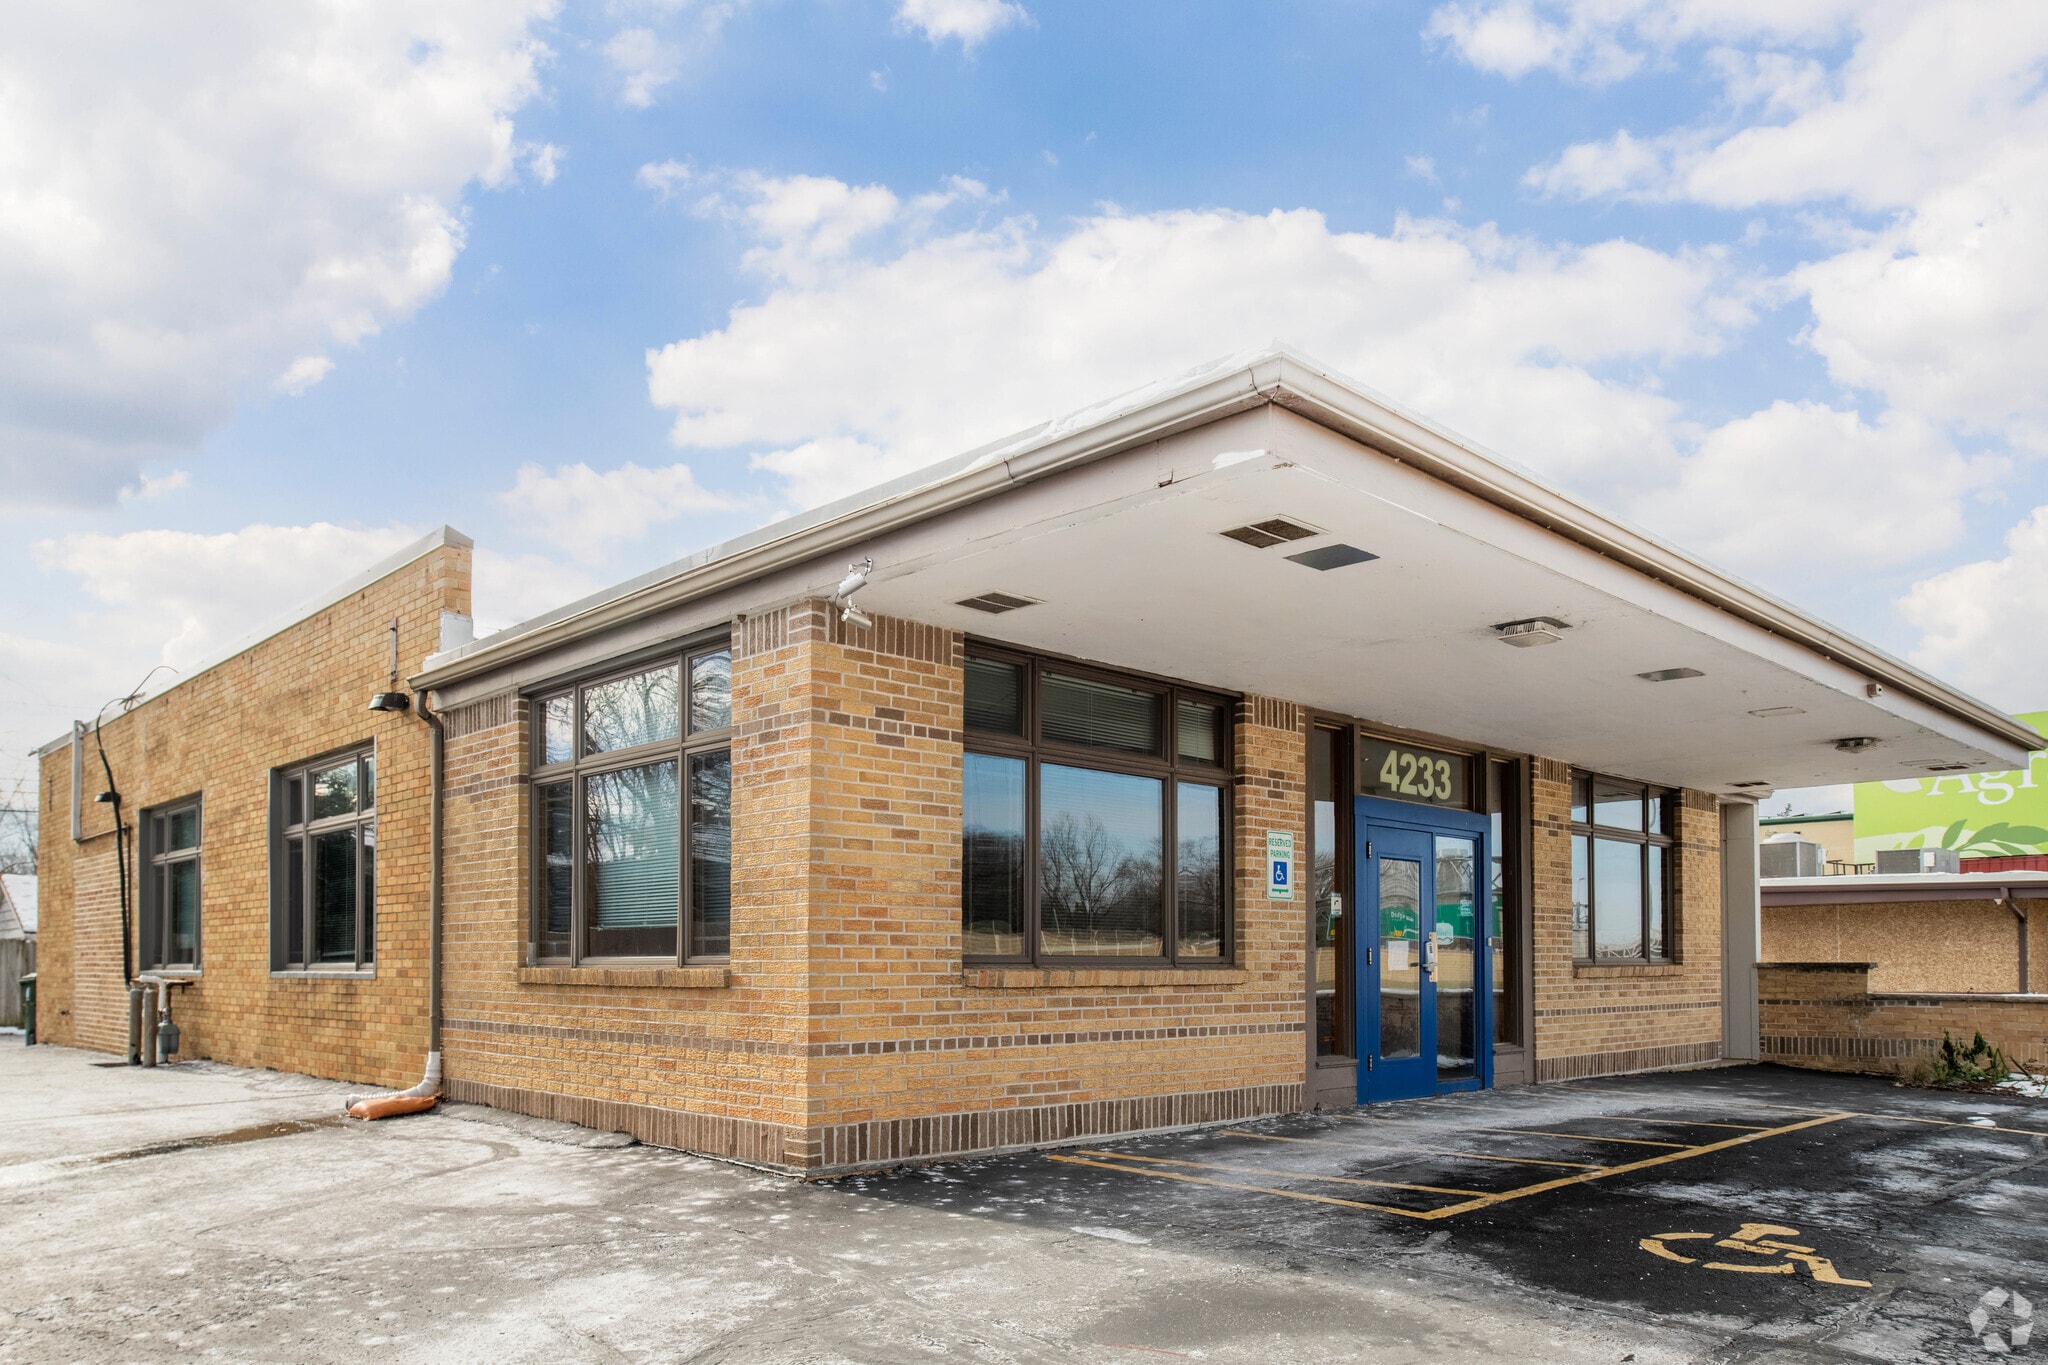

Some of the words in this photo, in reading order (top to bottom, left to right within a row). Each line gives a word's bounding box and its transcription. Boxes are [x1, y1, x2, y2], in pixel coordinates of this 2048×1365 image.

[1380, 749, 1452, 800] 4233
[1926, 750, 2048, 805] gr
[1268, 837, 1292, 848] RESERVED
[1270, 849, 1291, 859] PARKING
